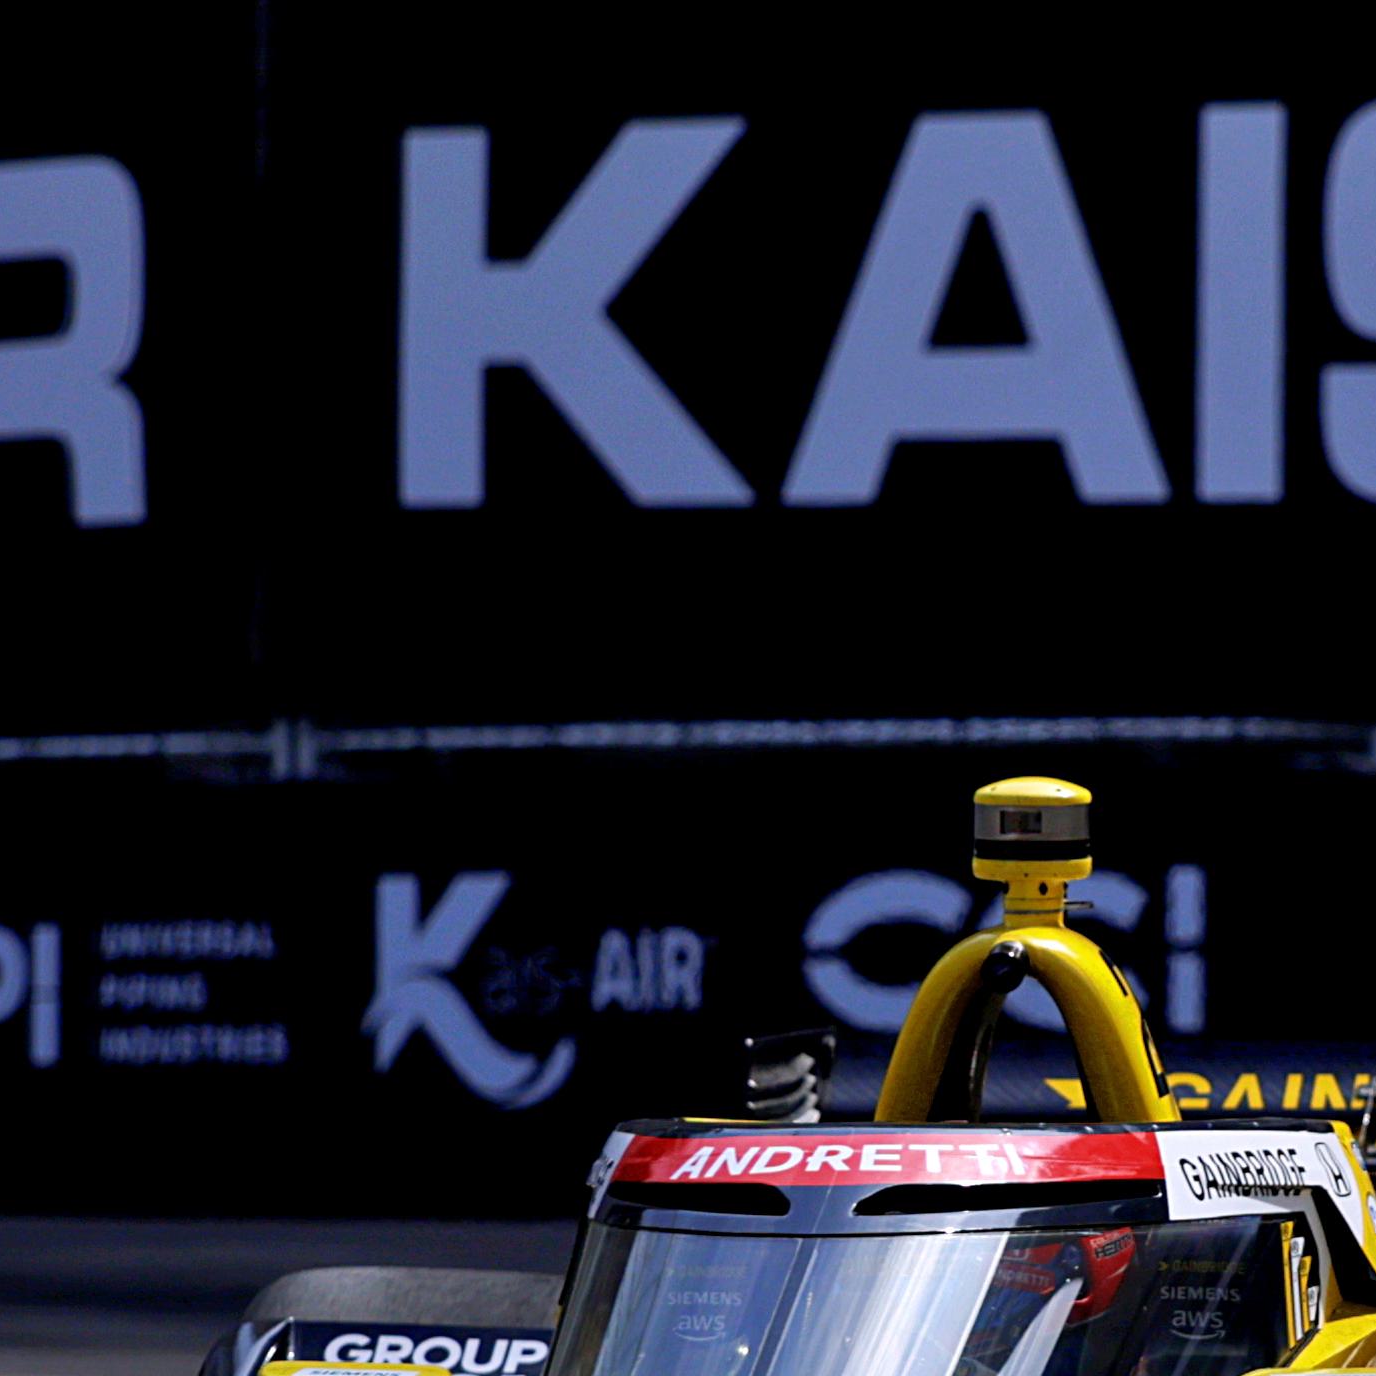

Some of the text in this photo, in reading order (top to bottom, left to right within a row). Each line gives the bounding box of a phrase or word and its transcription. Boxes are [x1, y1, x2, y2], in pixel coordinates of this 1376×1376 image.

[591, 926, 706, 1012] AIR
[670, 1142, 1027, 1180] ANDRETTI
[1179, 1148, 1306, 1200] GAINBRIDGE
[668, 1291, 742, 1305] SIEMENS
[1160, 1286, 1241, 1302] SIEMENS
[679, 1315, 727, 1332] aws
[1172, 1310, 1224, 1329] aws
[324, 1334, 549, 1374] GROUP
